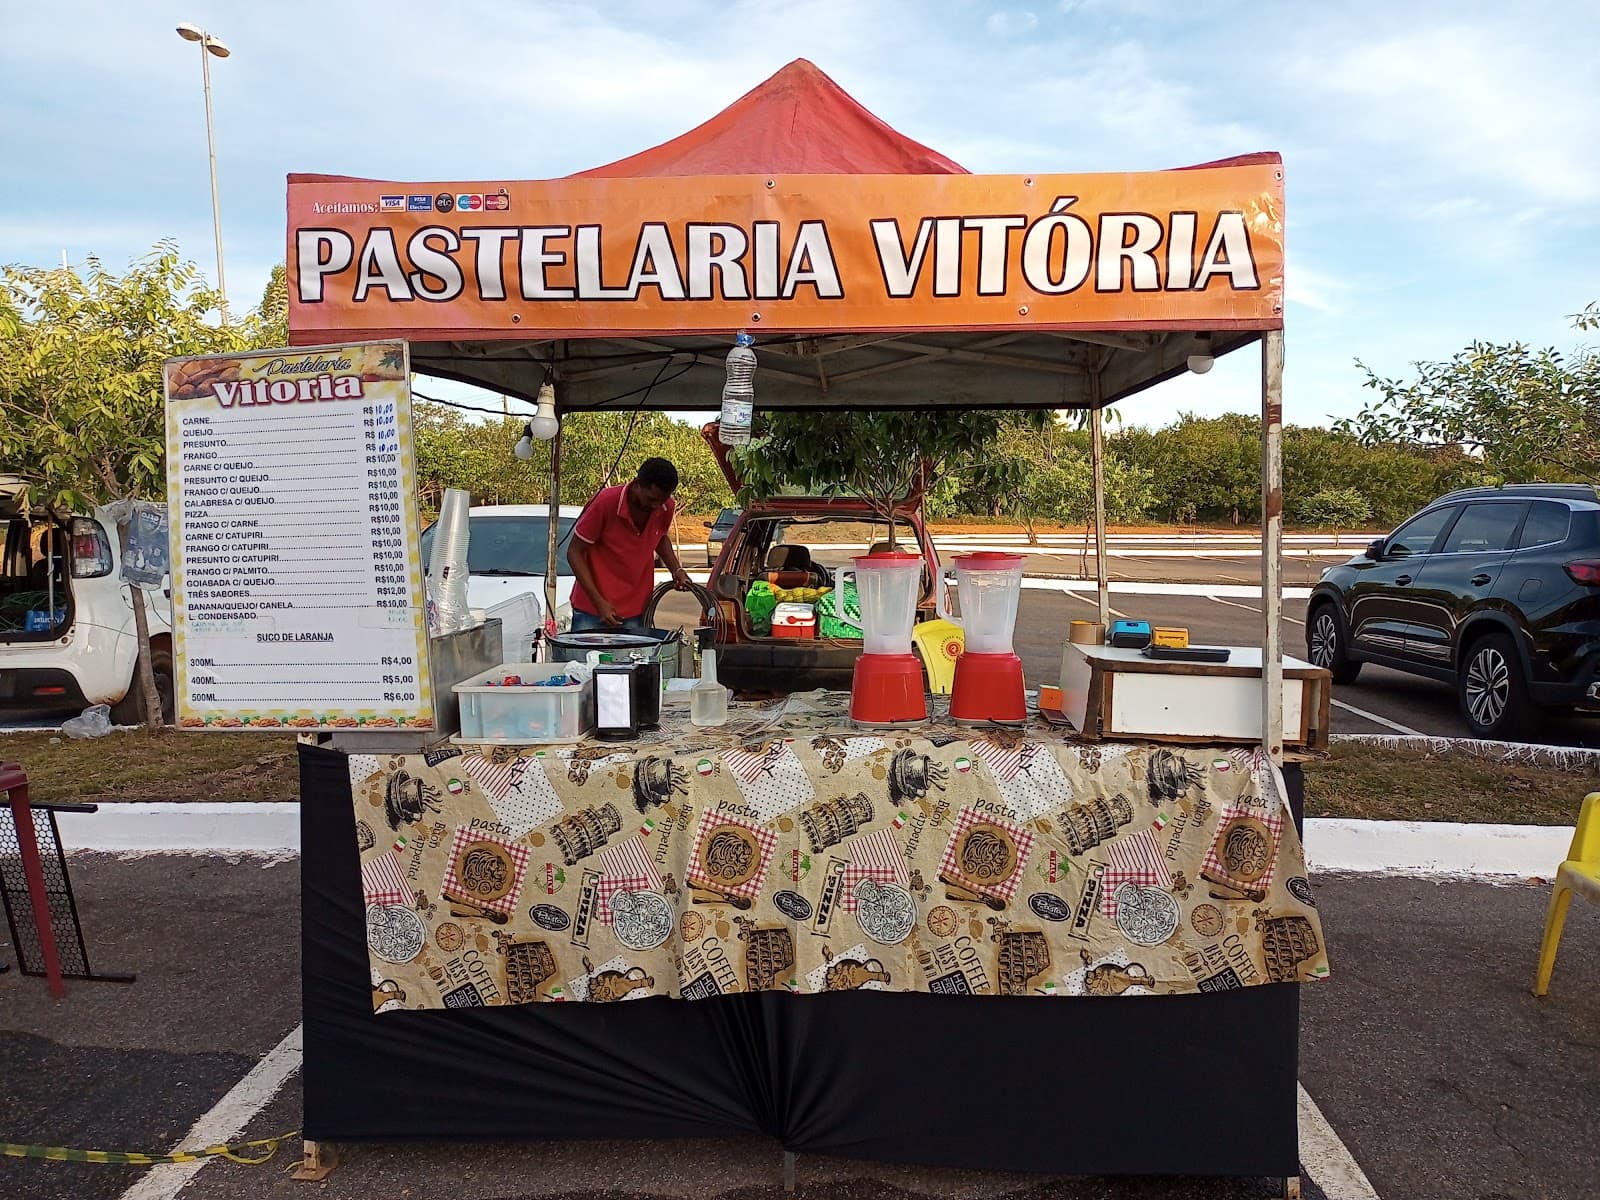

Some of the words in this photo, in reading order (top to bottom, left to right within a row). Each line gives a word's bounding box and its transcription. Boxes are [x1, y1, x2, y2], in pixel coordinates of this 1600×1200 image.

[312, 202, 379, 214] Aceitamos:
[384, 199, 401, 207] VISA
[437, 199, 452, 207] elo
[296, 220, 844, 303] PASTELARIA
[869, 195, 1261, 298] VITÓRIA
[252, 357, 352, 376] Pastelaria
[182, 417, 210, 425] CARNE
[363, 406, 374, 415] R$
[183, 429, 213, 437] QUEIJO
[364, 419, 374, 427] R$
[183, 440, 227, 449] PRESUNTO
[365, 431, 375, 439] R$
[183, 452, 218, 460] FRANGO
[366, 443, 376, 451] R$
[184, 464, 212, 472] CARNE
[223, 461, 253, 470] QUEIJO
[366, 454, 396, 463] R$10,00
[184, 476, 228, 485] PRESUNTO
[239, 474, 269, 483] QUEIJO
[367, 468, 397, 477] R$10,00
[184, 488, 219, 497] FRANGO
[230, 486, 260, 495] QUEIJO
[368, 480, 397, 489] R$10,00
[184, 499, 233, 508] CALABRESA
[244, 497, 275, 505] QUEIJO
[369, 491, 398, 501] R$10,00
[369, 503, 399, 512] R$10,00
[185, 521, 219, 529] FRANGO
[231, 519, 259, 528] CARNE
[370, 514, 400, 524] R$10,00
[185, 533, 214, 541] CARNE
[225, 531, 263, 540] CATUPIRI
[371, 527, 401, 536] R$10,00
[185, 544, 220, 553] FRANGO
[231, 543, 269, 551] CATUPIRI
[372, 539, 402, 548] R$10,00
[186, 556, 230, 565] PRESUNTO
[241, 554, 279, 563] CATUPIRI
[373, 551, 403, 560] R$10,00
[186, 568, 221, 576] FRANGO
[233, 567, 268, 575] PALMITO
[374, 564, 404, 573] R$10,00
[186, 579, 231, 587] GOIABADA
[243, 578, 275, 586] QUEIJO
[375, 576, 405, 584] R$10,00
[187, 590, 209, 598] TRÊS
[210, 590, 250, 598] SABORES
[377, 587, 406, 596] R$12,00
[259, 601, 293, 609] CANELA
[376, 599, 407, 609] R$10,00
[256, 633, 280, 642] SUCO
[281, 633, 294, 641] DE
[295, 632, 334, 642] LARANJA
[190, 658, 216, 667] 300ML
[381, 657, 412, 666] R$4,00
[191, 676, 216, 685] 400ML
[382, 675, 413, 684] R$5,00
[192, 693, 217, 702] 500ML
[383, 692, 415, 701] R$6,00
[676, 803, 694, 832] Buon
[715, 799, 760, 820] pasta
[929, 799, 950, 828] Buon
[972, 797, 1017, 821] pasta
[1191, 798, 1212, 828] Buon
[429, 822, 446, 849] Buon
[469, 817, 513, 836] pasta
[817, 875, 836, 925] PIZZA
[1075, 879, 1096, 928] PIZZA
[576, 886, 592, 936] PIZZA
[701, 937, 740, 992] COFFEE
[954, 936, 991, 994] COFFEE
[1223, 934, 1260, 985] COFFEE
[463, 950, 501, 1004] COFFEE
[701, 974, 720, 997] HOT
[1222, 970, 1240, 989] HOT
[465, 985, 482, 1007] HOT
